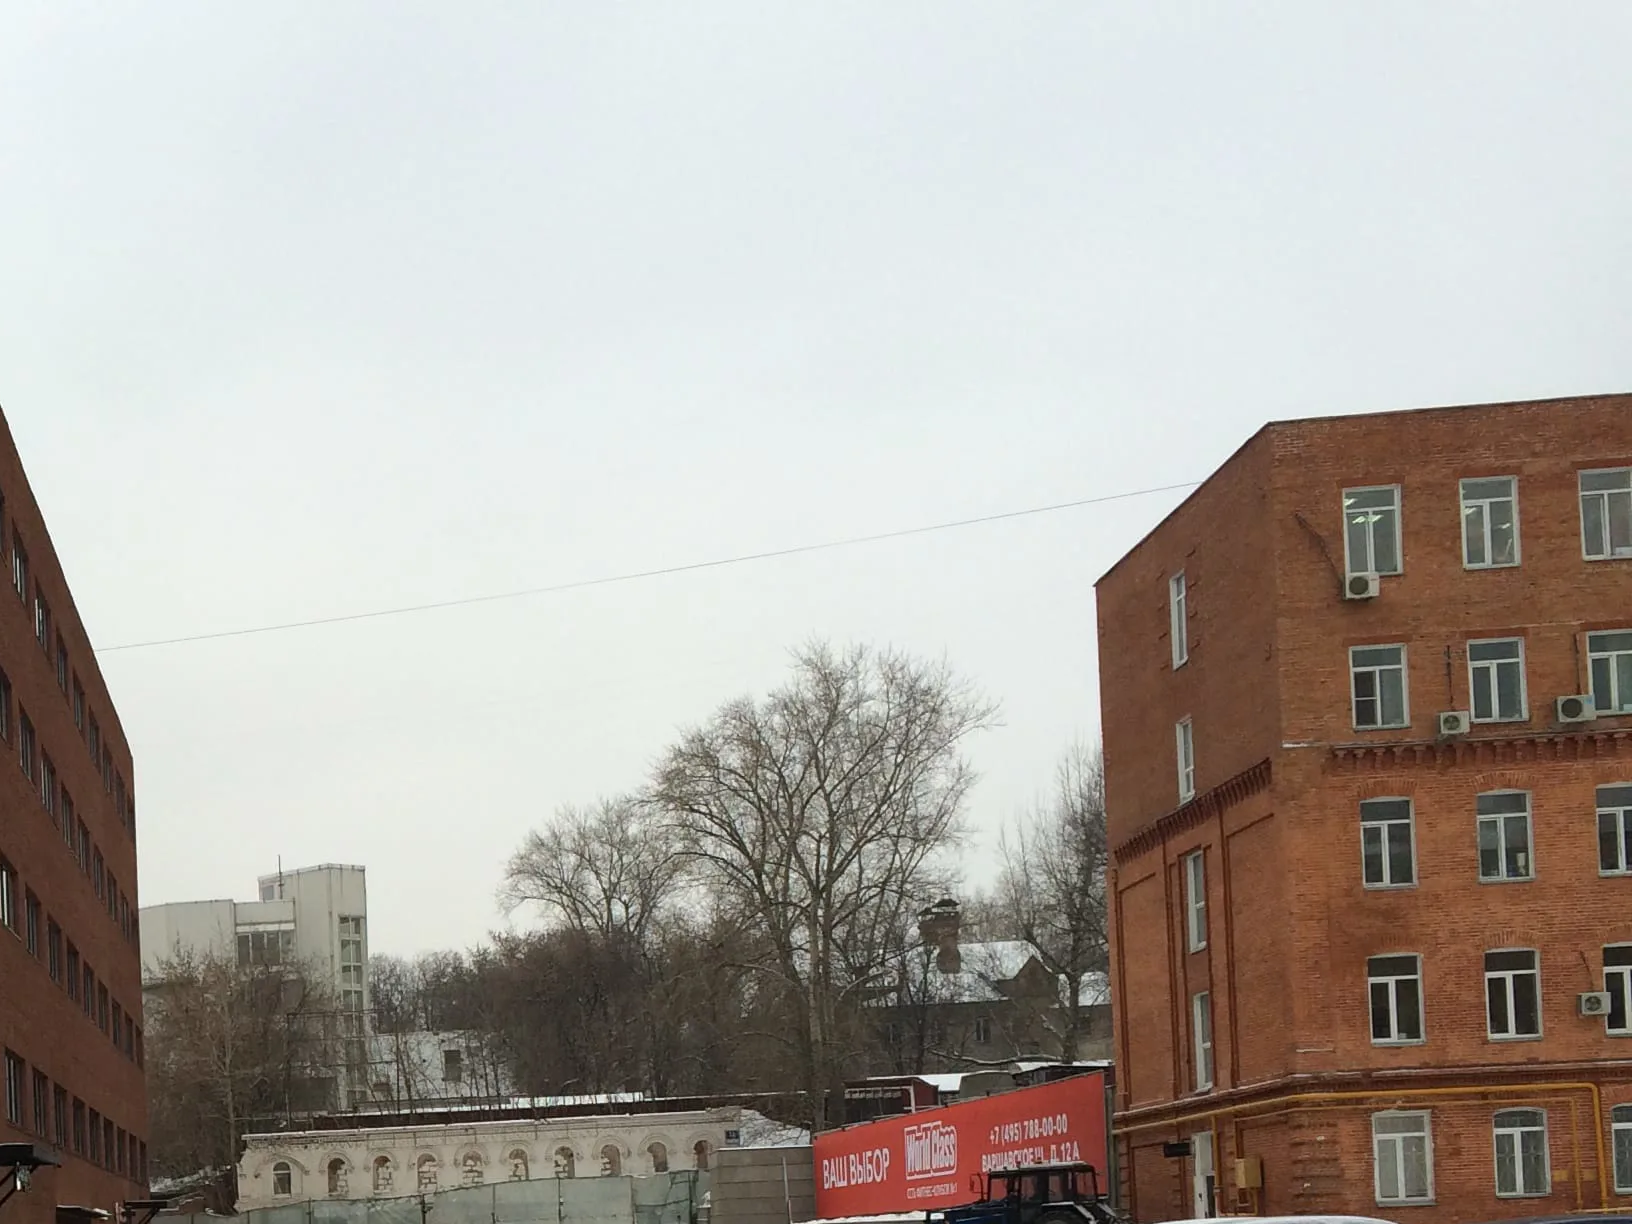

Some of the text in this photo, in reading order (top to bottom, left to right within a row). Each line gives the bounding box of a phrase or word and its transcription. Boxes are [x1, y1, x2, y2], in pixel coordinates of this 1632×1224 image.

[1001, 1121, 1022, 1146] (495)
[1023, 1113, 1068, 1140] 788-00-00
[823, 1148, 890, 1190] ВАШ ВЫБОР
[906, 1129, 956, 1173] World Class
